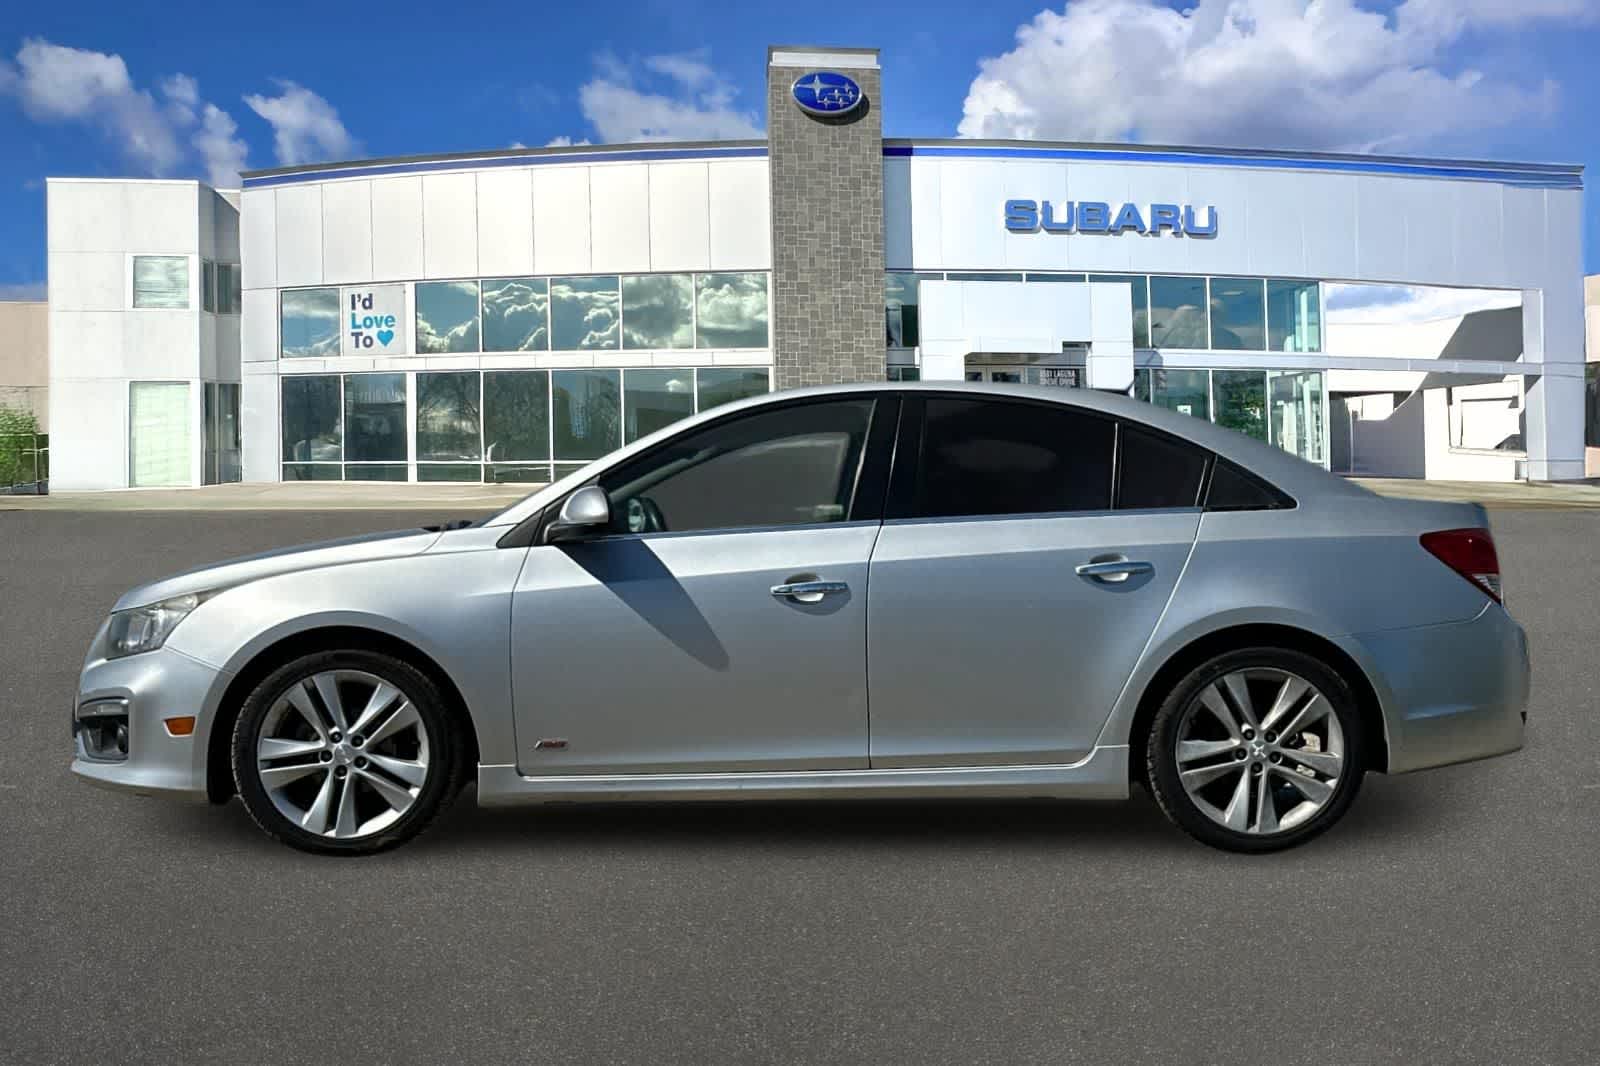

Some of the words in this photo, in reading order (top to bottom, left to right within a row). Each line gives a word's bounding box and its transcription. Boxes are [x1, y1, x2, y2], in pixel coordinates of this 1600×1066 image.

[1004, 199, 1217, 236] SUBARU
[350, 293, 374, 310] I'd
[351, 313, 396, 330] Love
[350, 331, 374, 348] To
